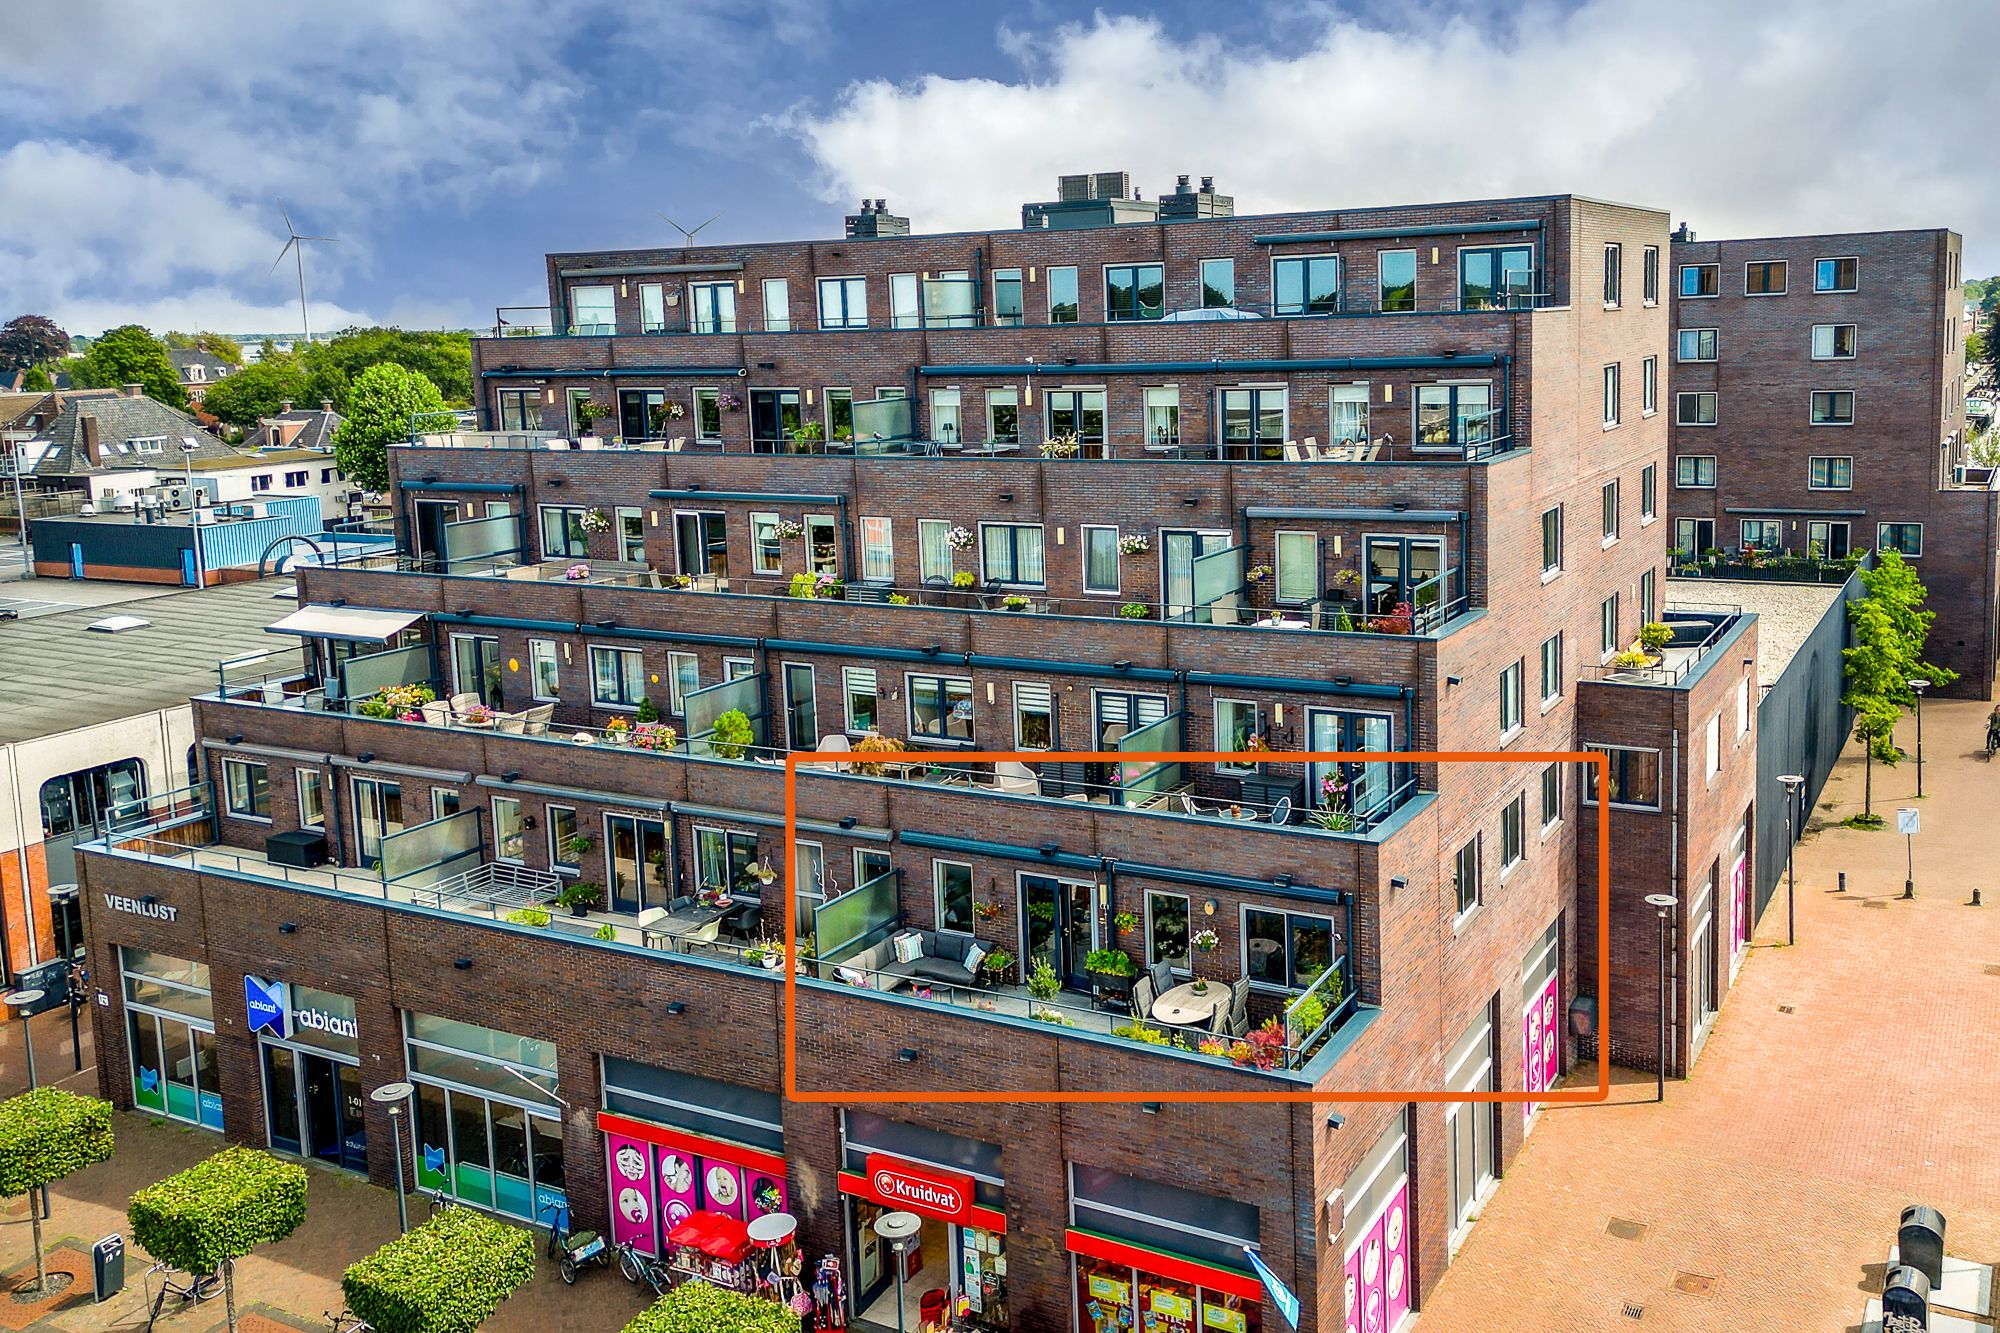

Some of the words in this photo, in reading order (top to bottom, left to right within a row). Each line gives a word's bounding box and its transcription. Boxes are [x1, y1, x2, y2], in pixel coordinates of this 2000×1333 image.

[104, 893, 177, 922] VEENLUST
[249, 1000, 277, 1014] abiant
[896, 1179, 956, 1209] Kruidvat
